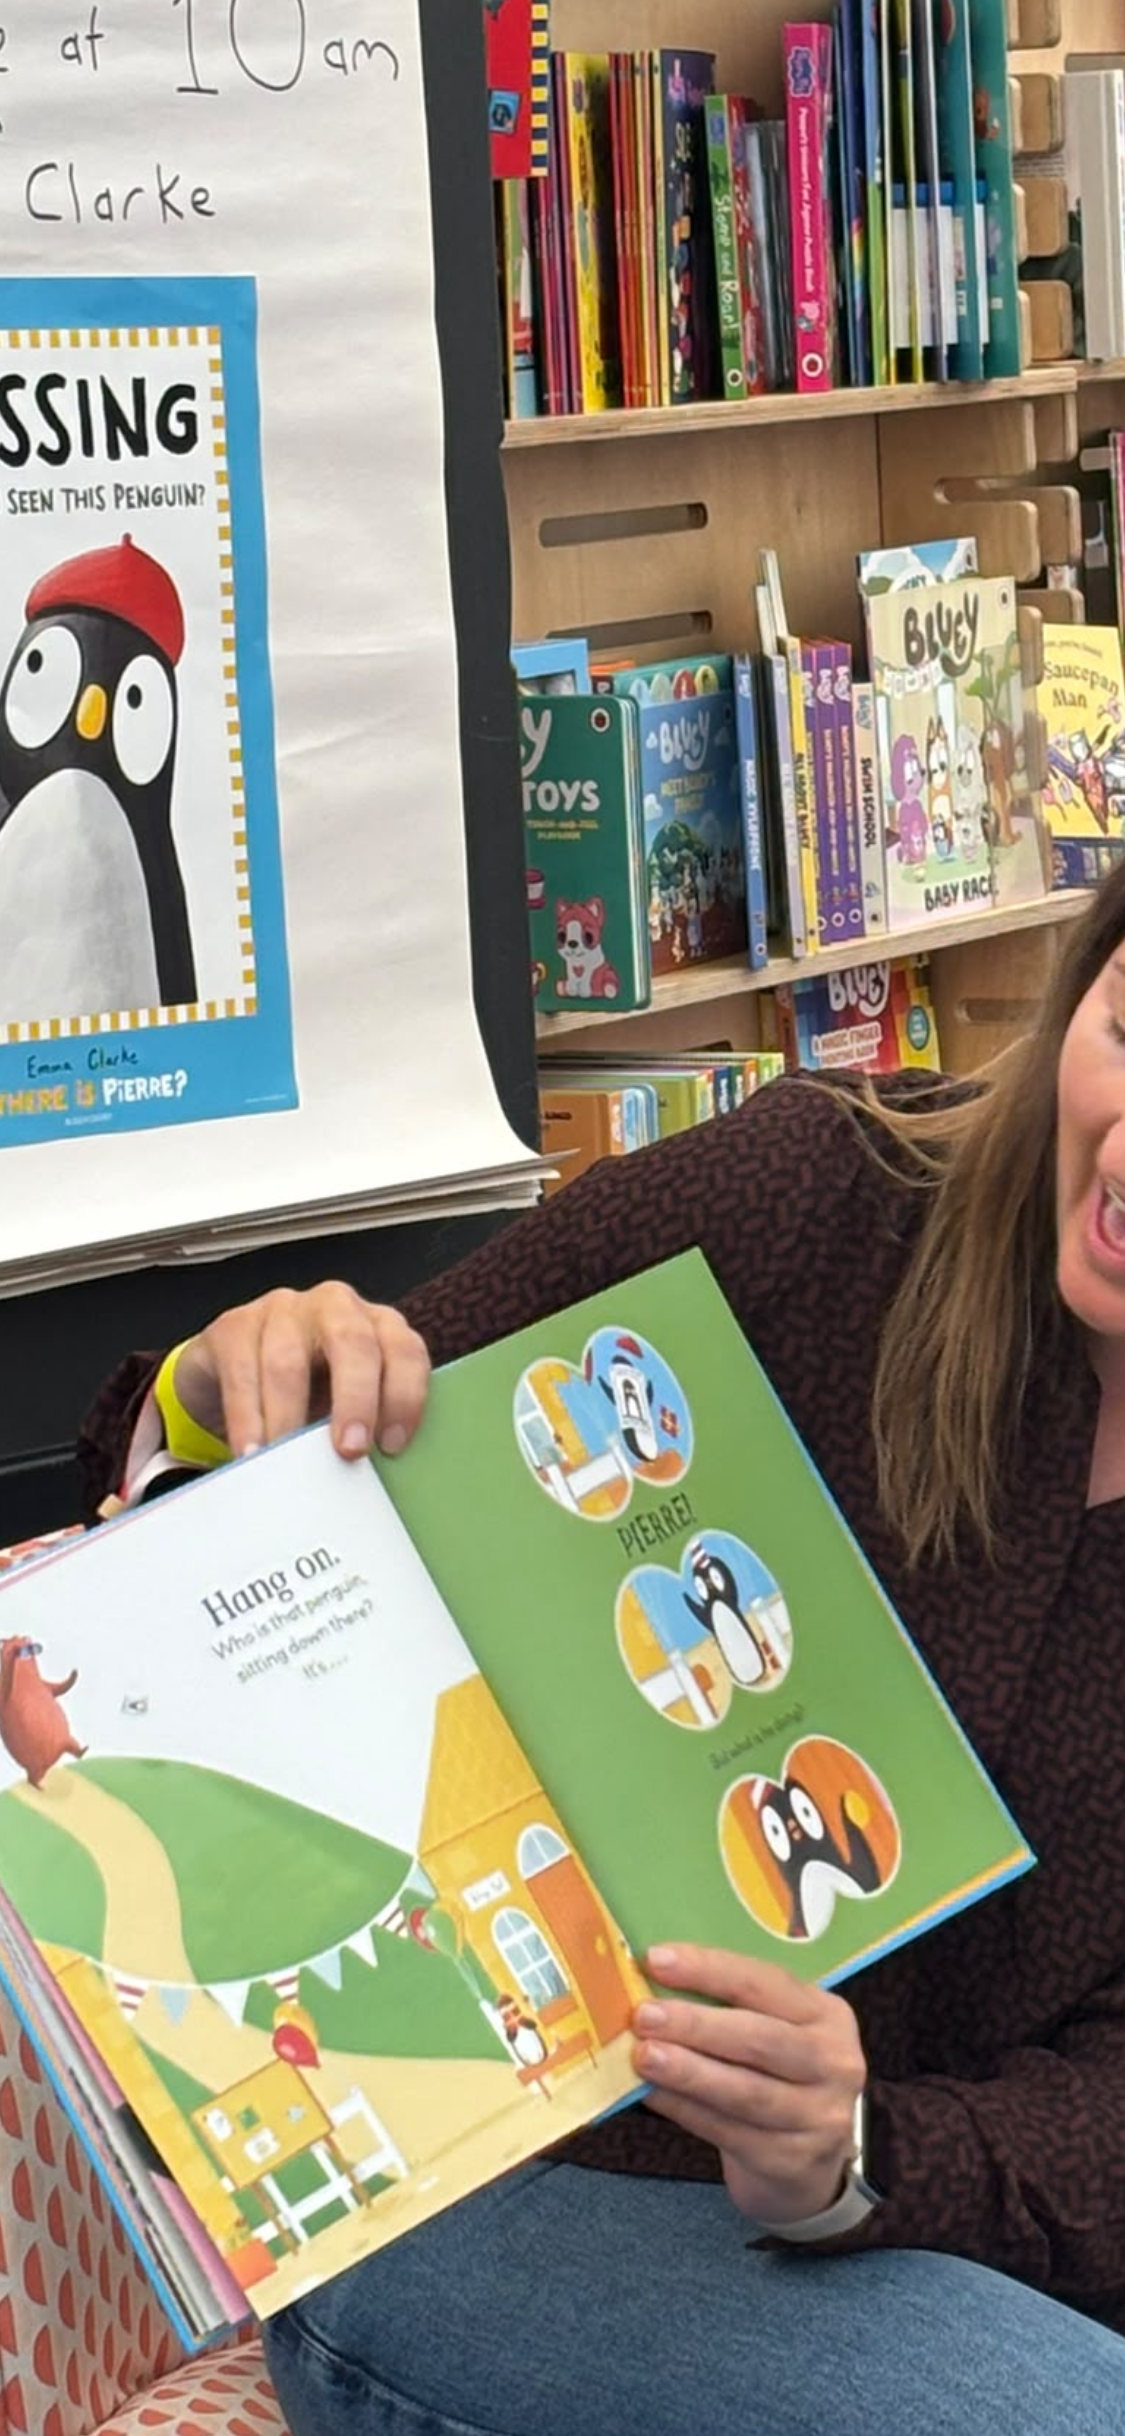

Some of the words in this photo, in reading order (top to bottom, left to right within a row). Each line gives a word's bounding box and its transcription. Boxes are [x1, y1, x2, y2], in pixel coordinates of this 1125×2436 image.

[61, 6, 103, 71] at
[26, 163, 216, 224] Clarke
[715, 194, 731, 247] Stomp
[720, 281, 740, 329] Roar!
[0, 373, 198, 467] SSING
[7, 488, 54, 515] SEEN
[61, 485, 106, 513] THIS
[114, 483, 206, 509] PENGUIN?
[1052, 688, 1088, 709] Man
[522, 780, 600, 812] TOYS
[861, 757, 874, 794] SWIM
[863, 796, 878, 848] SCHOOL
[924, 882, 960, 912] BABY
[27, 1055, 73, 1078] Emma
[88, 1047, 138, 1071] Clarke
[0, 1083, 68, 1116] HERE
[616, 1491, 698, 1559] PIERRE!
[202, 1572, 294, 1628] Hang
[295, 1547, 341, 1580] on.
[212, 1632, 256, 1660] Who
[254, 1622, 271, 1638] is
[268, 1603, 305, 1631] that
[237, 1647, 290, 1684] sitting
[288, 1624, 330, 1654] down
[329, 1598, 374, 1632] there?
